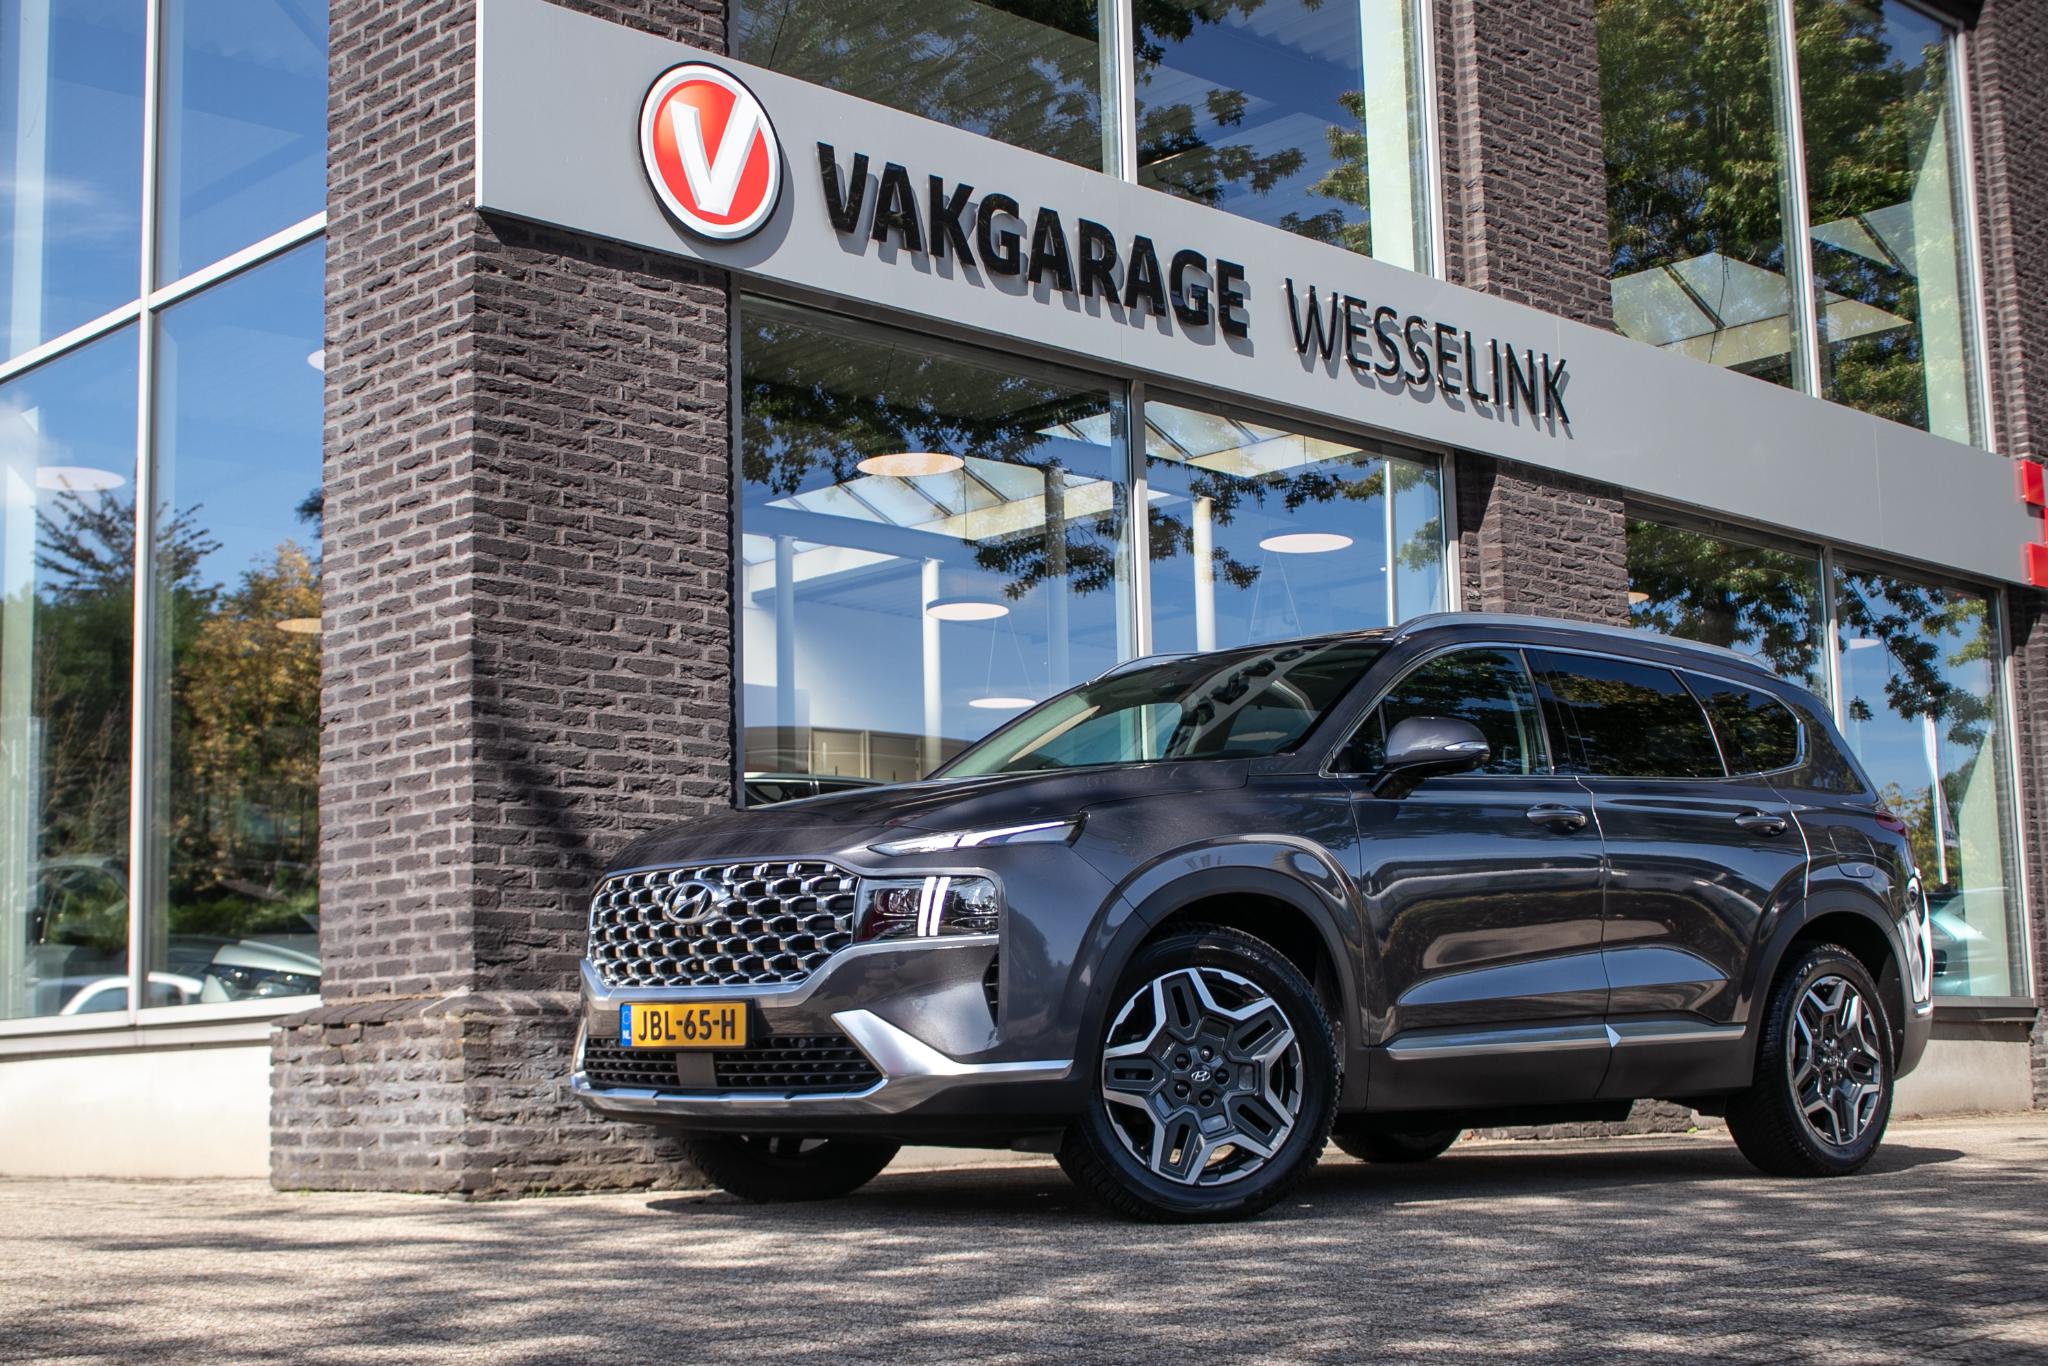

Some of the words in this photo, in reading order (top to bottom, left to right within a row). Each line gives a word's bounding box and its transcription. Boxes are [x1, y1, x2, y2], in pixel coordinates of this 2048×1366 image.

[669, 87, 762, 217] V
[816, 141, 1248, 338] VAKGARAGE
[1285, 277, 1570, 424] WESSELINK
[622, 1030, 632, 1040] NL
[638, 1008, 736, 1041] JBL-65-H
